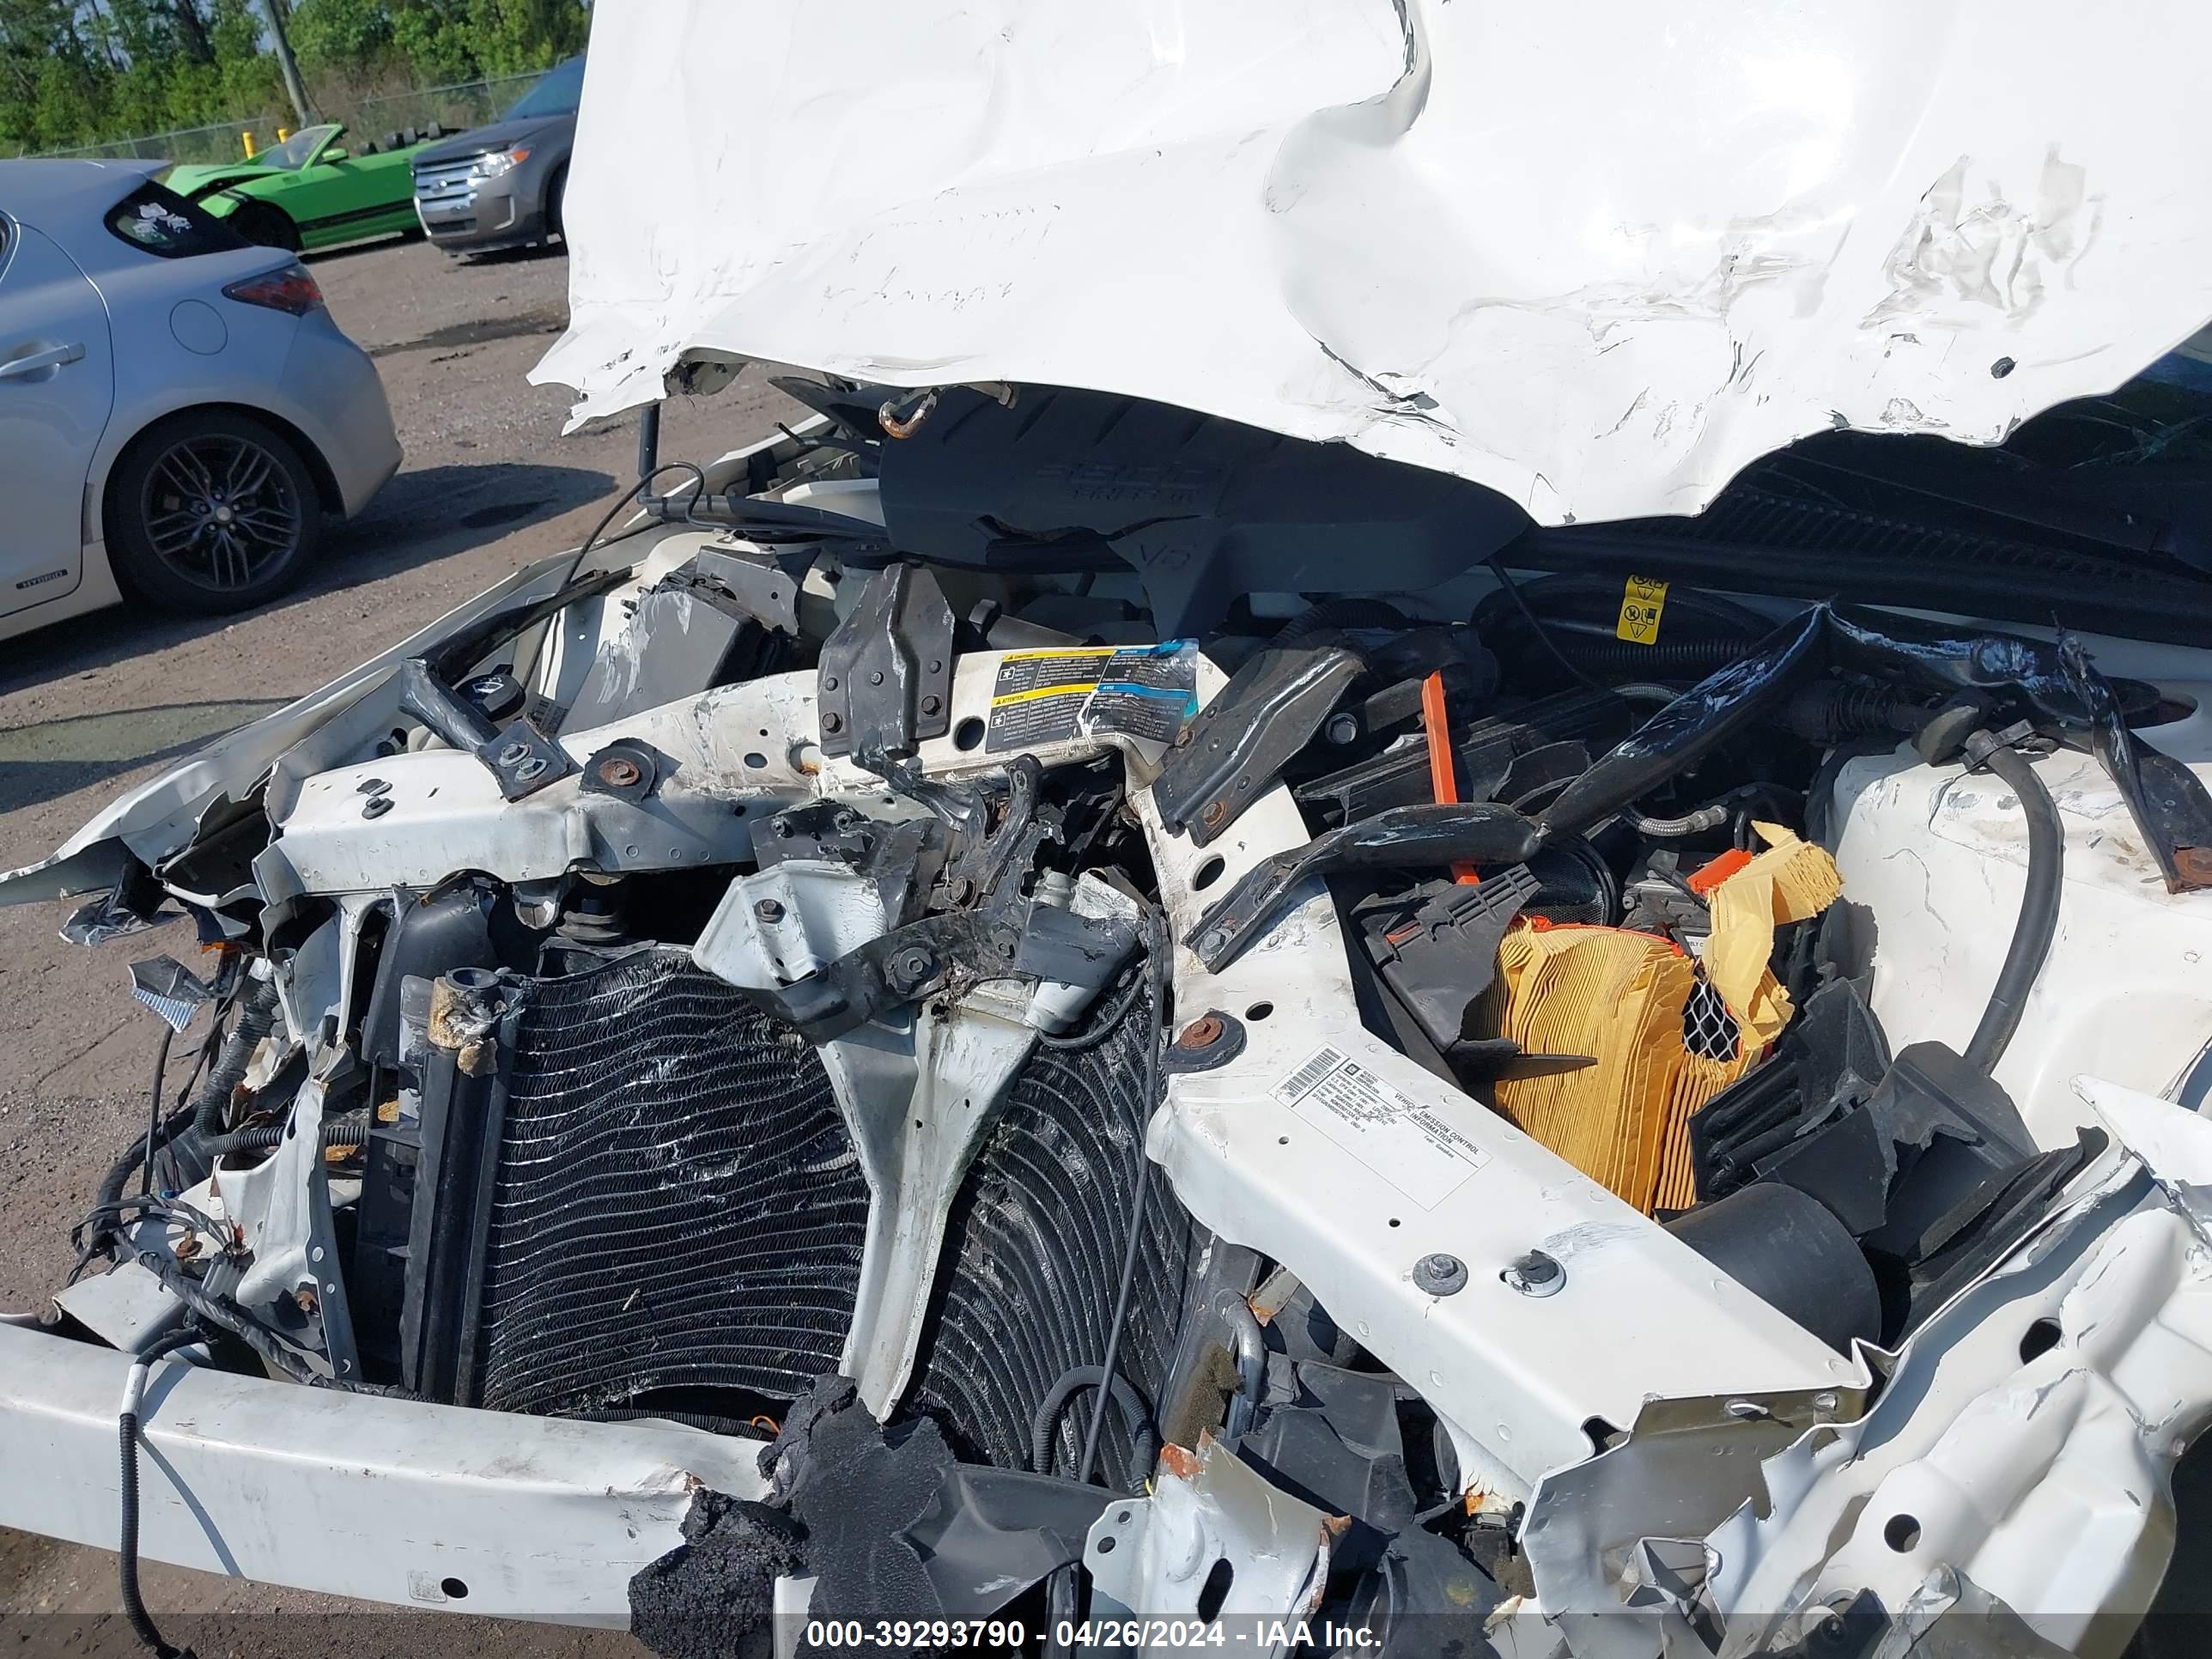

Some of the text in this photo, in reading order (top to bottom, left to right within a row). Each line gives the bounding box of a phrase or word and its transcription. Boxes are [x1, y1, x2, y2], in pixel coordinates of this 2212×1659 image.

[1410, 1112, 1453, 1144] INFORMATION
[1419, 1110, 1450, 1133] EMISSION
[1449, 1132, 1480, 1155] CONTROL
